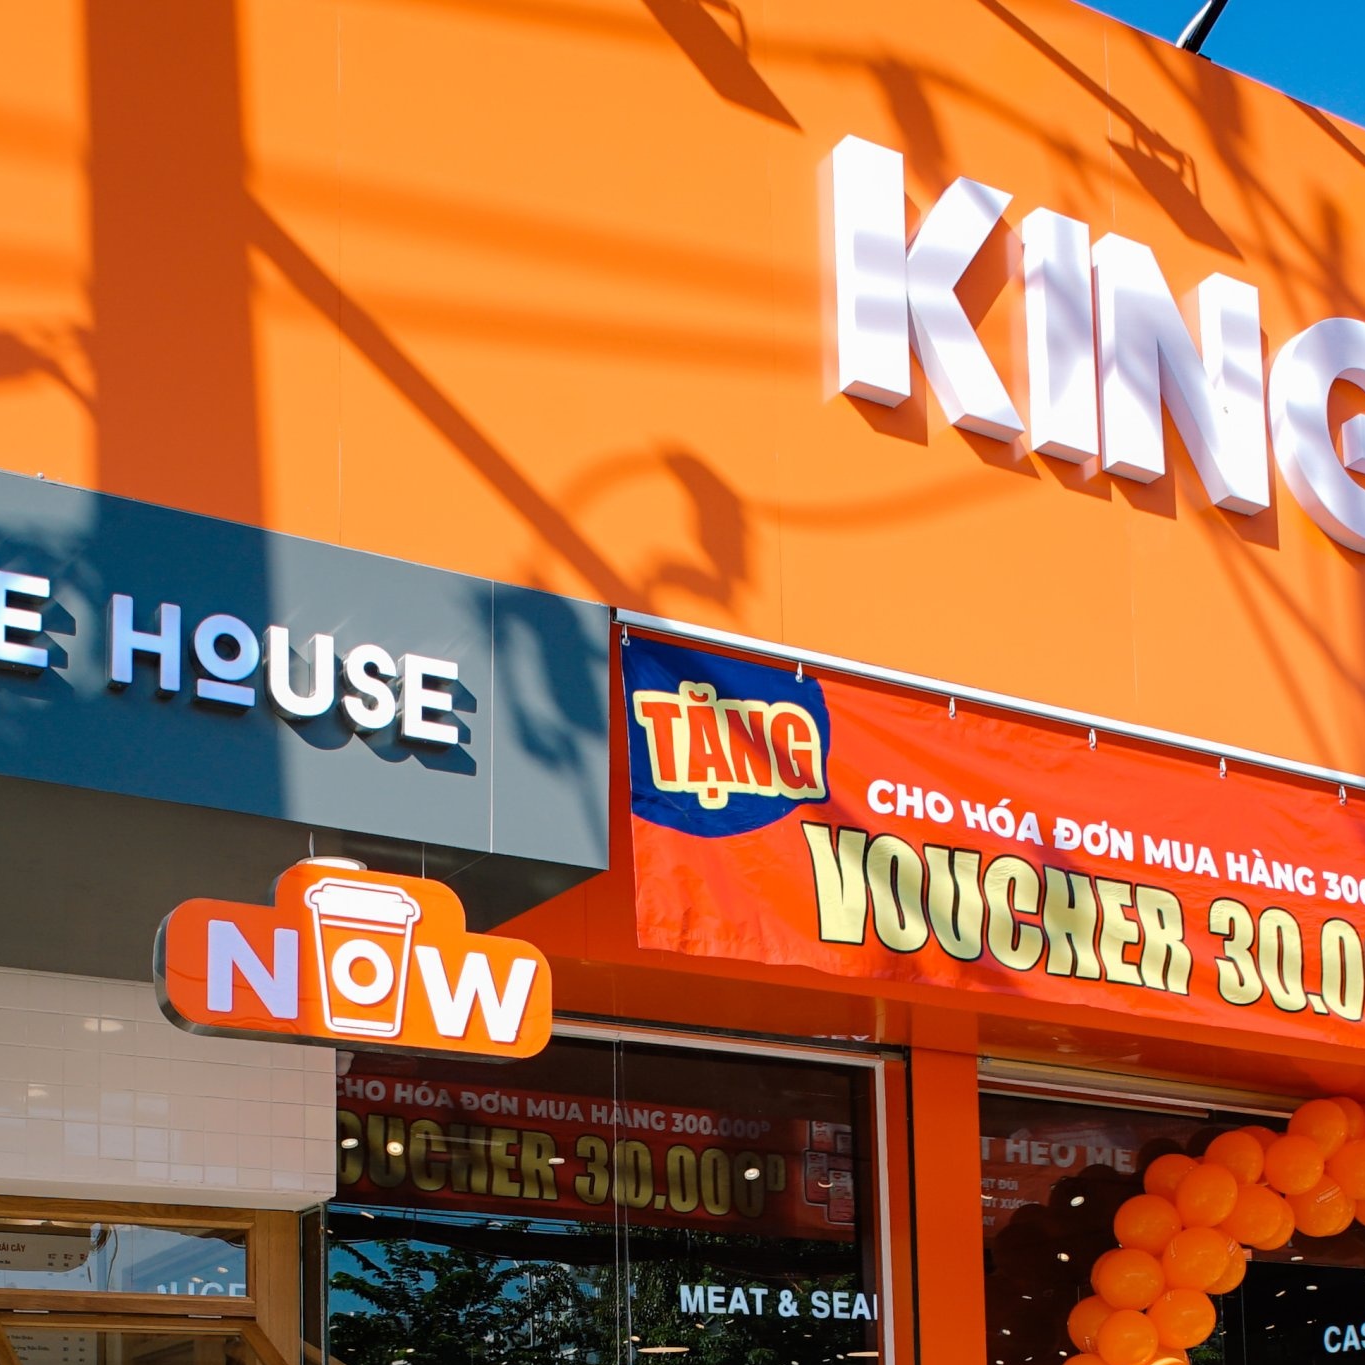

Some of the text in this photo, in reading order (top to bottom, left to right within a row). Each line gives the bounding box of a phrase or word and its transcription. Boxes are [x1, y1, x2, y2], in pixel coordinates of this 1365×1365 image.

[108, 594, 461, 747] HOUSE
[634, 682, 825, 807] TẶNG
[866, 778, 954, 824] CHO
[960, 798, 1044, 846] HÓA
[1052, 817, 1134, 862] ĐƠN
[1142, 834, 1219, 879] MUA
[1225, 848, 1316, 897] HÀNG
[799, 820, 1193, 996] VOUCHER
[207, 918, 538, 1044] NOW
[393, 1079, 454, 1109] HÓA
[459, 1090, 520, 1116] ĐƠN
[526, 1099, 585, 1122] MUA
[679, 1284, 878, 1321] MEAT & SEA
